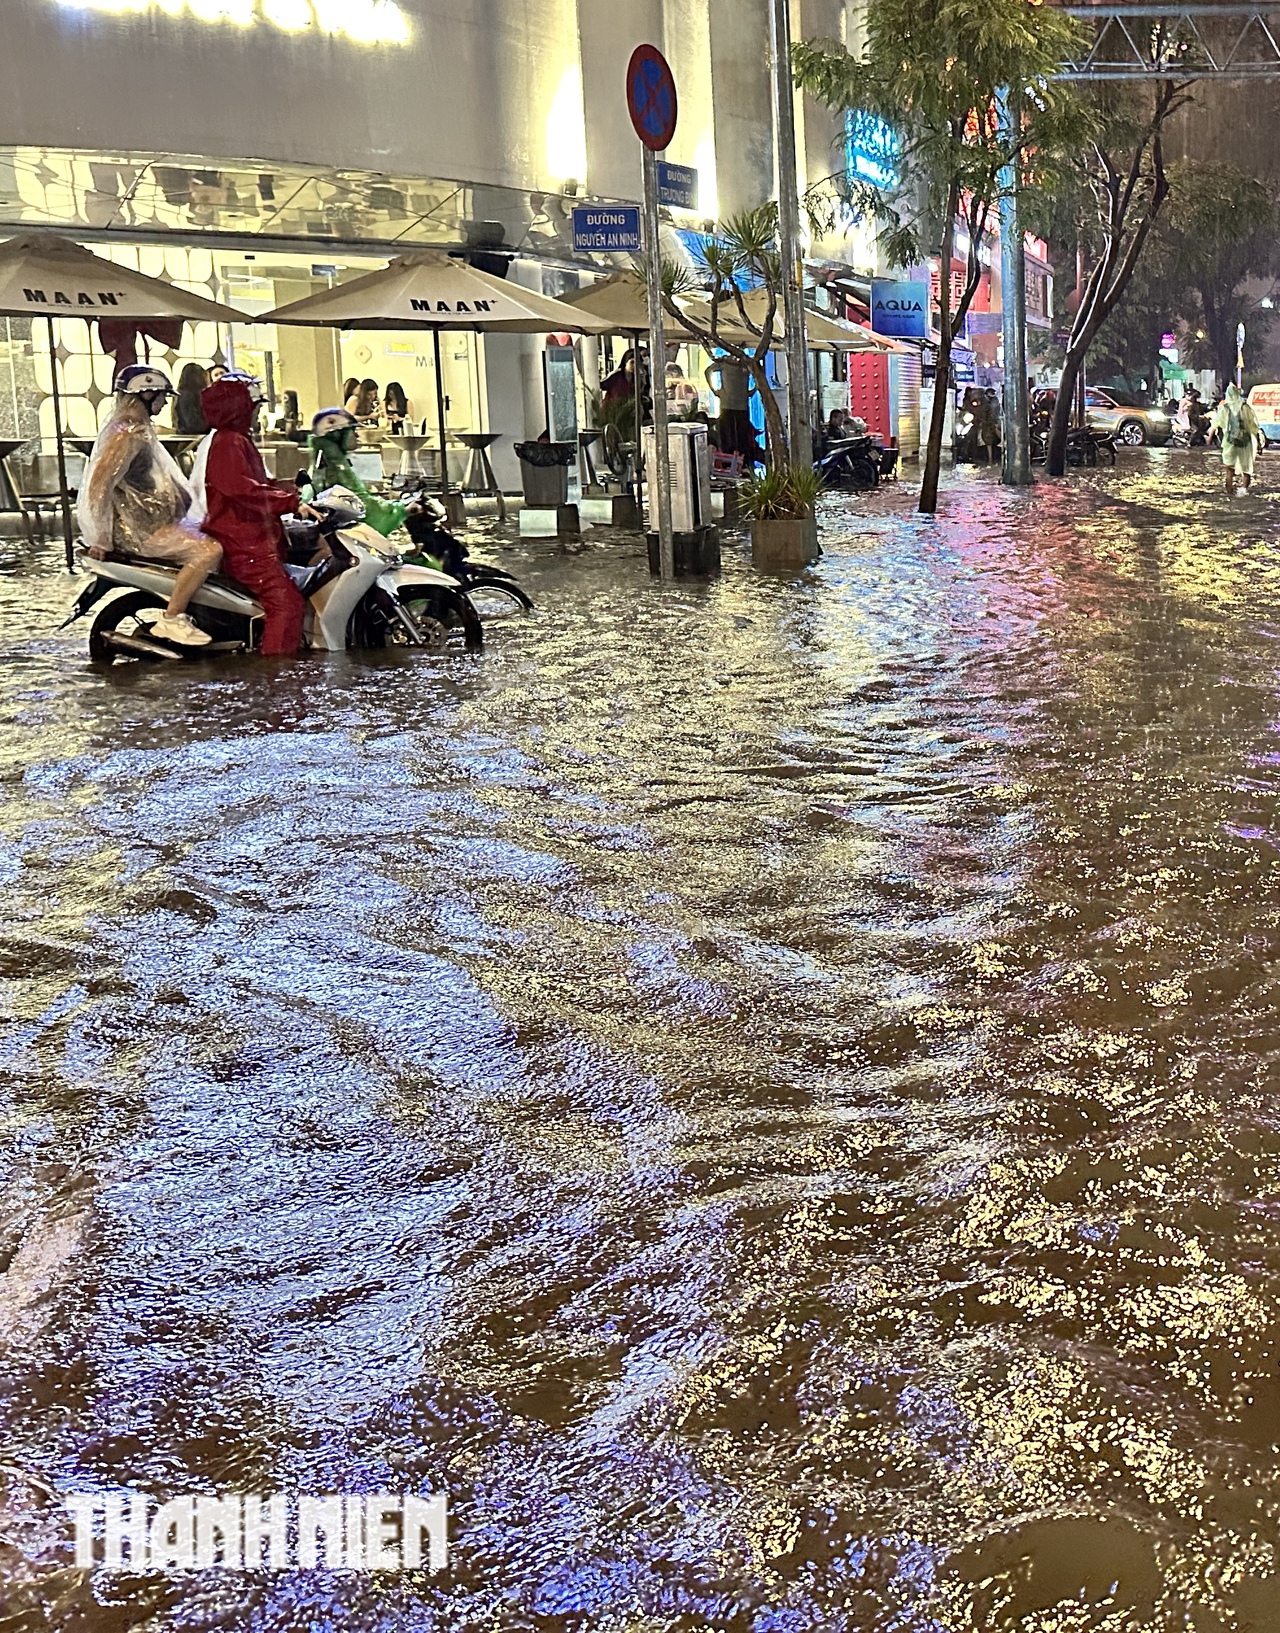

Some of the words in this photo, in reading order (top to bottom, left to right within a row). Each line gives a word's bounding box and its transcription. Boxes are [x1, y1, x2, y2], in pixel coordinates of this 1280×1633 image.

[667, 169, 692, 185] ĐƯỜNG
[586, 212, 626, 225] ĐƯỜNG
[607, 233, 618, 247] AN
[620, 232, 638, 247] NINH
[875, 300, 923, 311] AQUA
